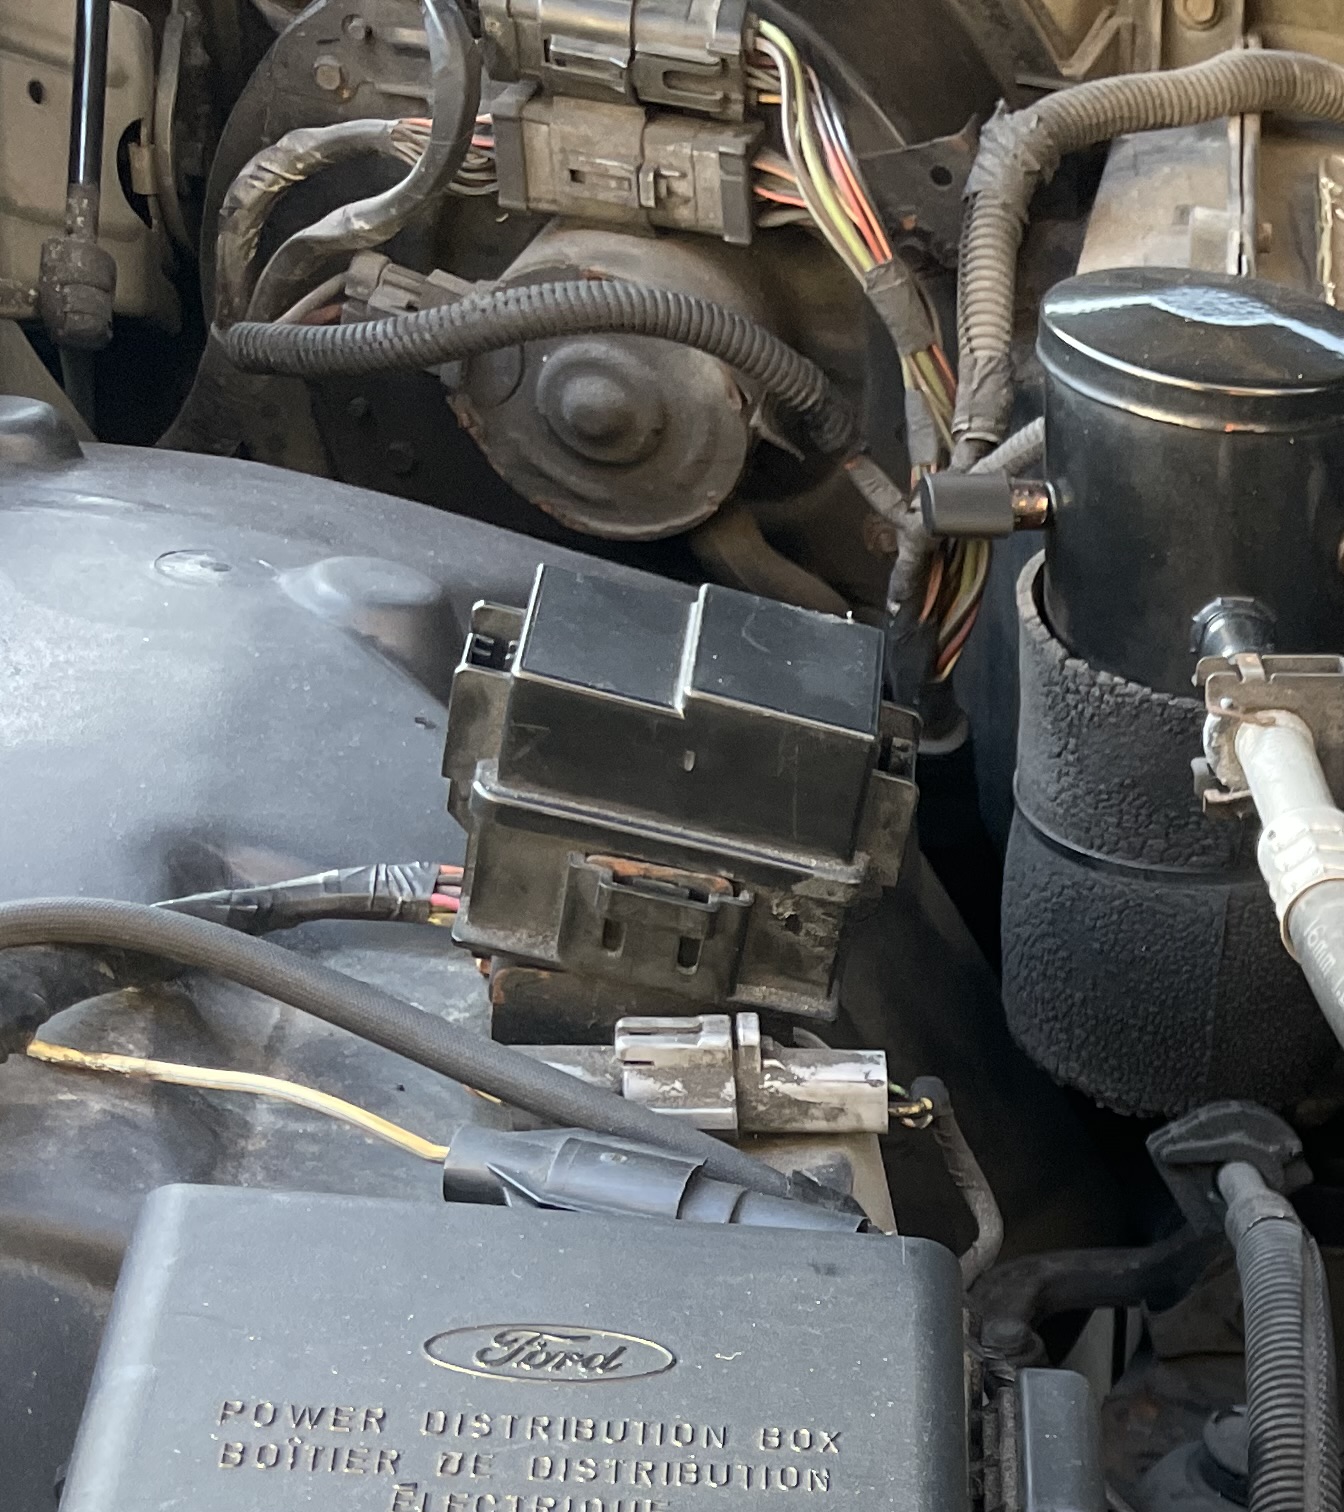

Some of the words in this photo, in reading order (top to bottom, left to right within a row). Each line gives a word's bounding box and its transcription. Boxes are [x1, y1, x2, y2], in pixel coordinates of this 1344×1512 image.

[473, 1329, 628, 1374] Ford
[216, 1400, 388, 1434] POWER
[419, 1409, 727, 1449] DISTRIBUTION
[757, 1426, 842, 1454] BOX
[526, 1455, 832, 1492] DISTRIBUTION
